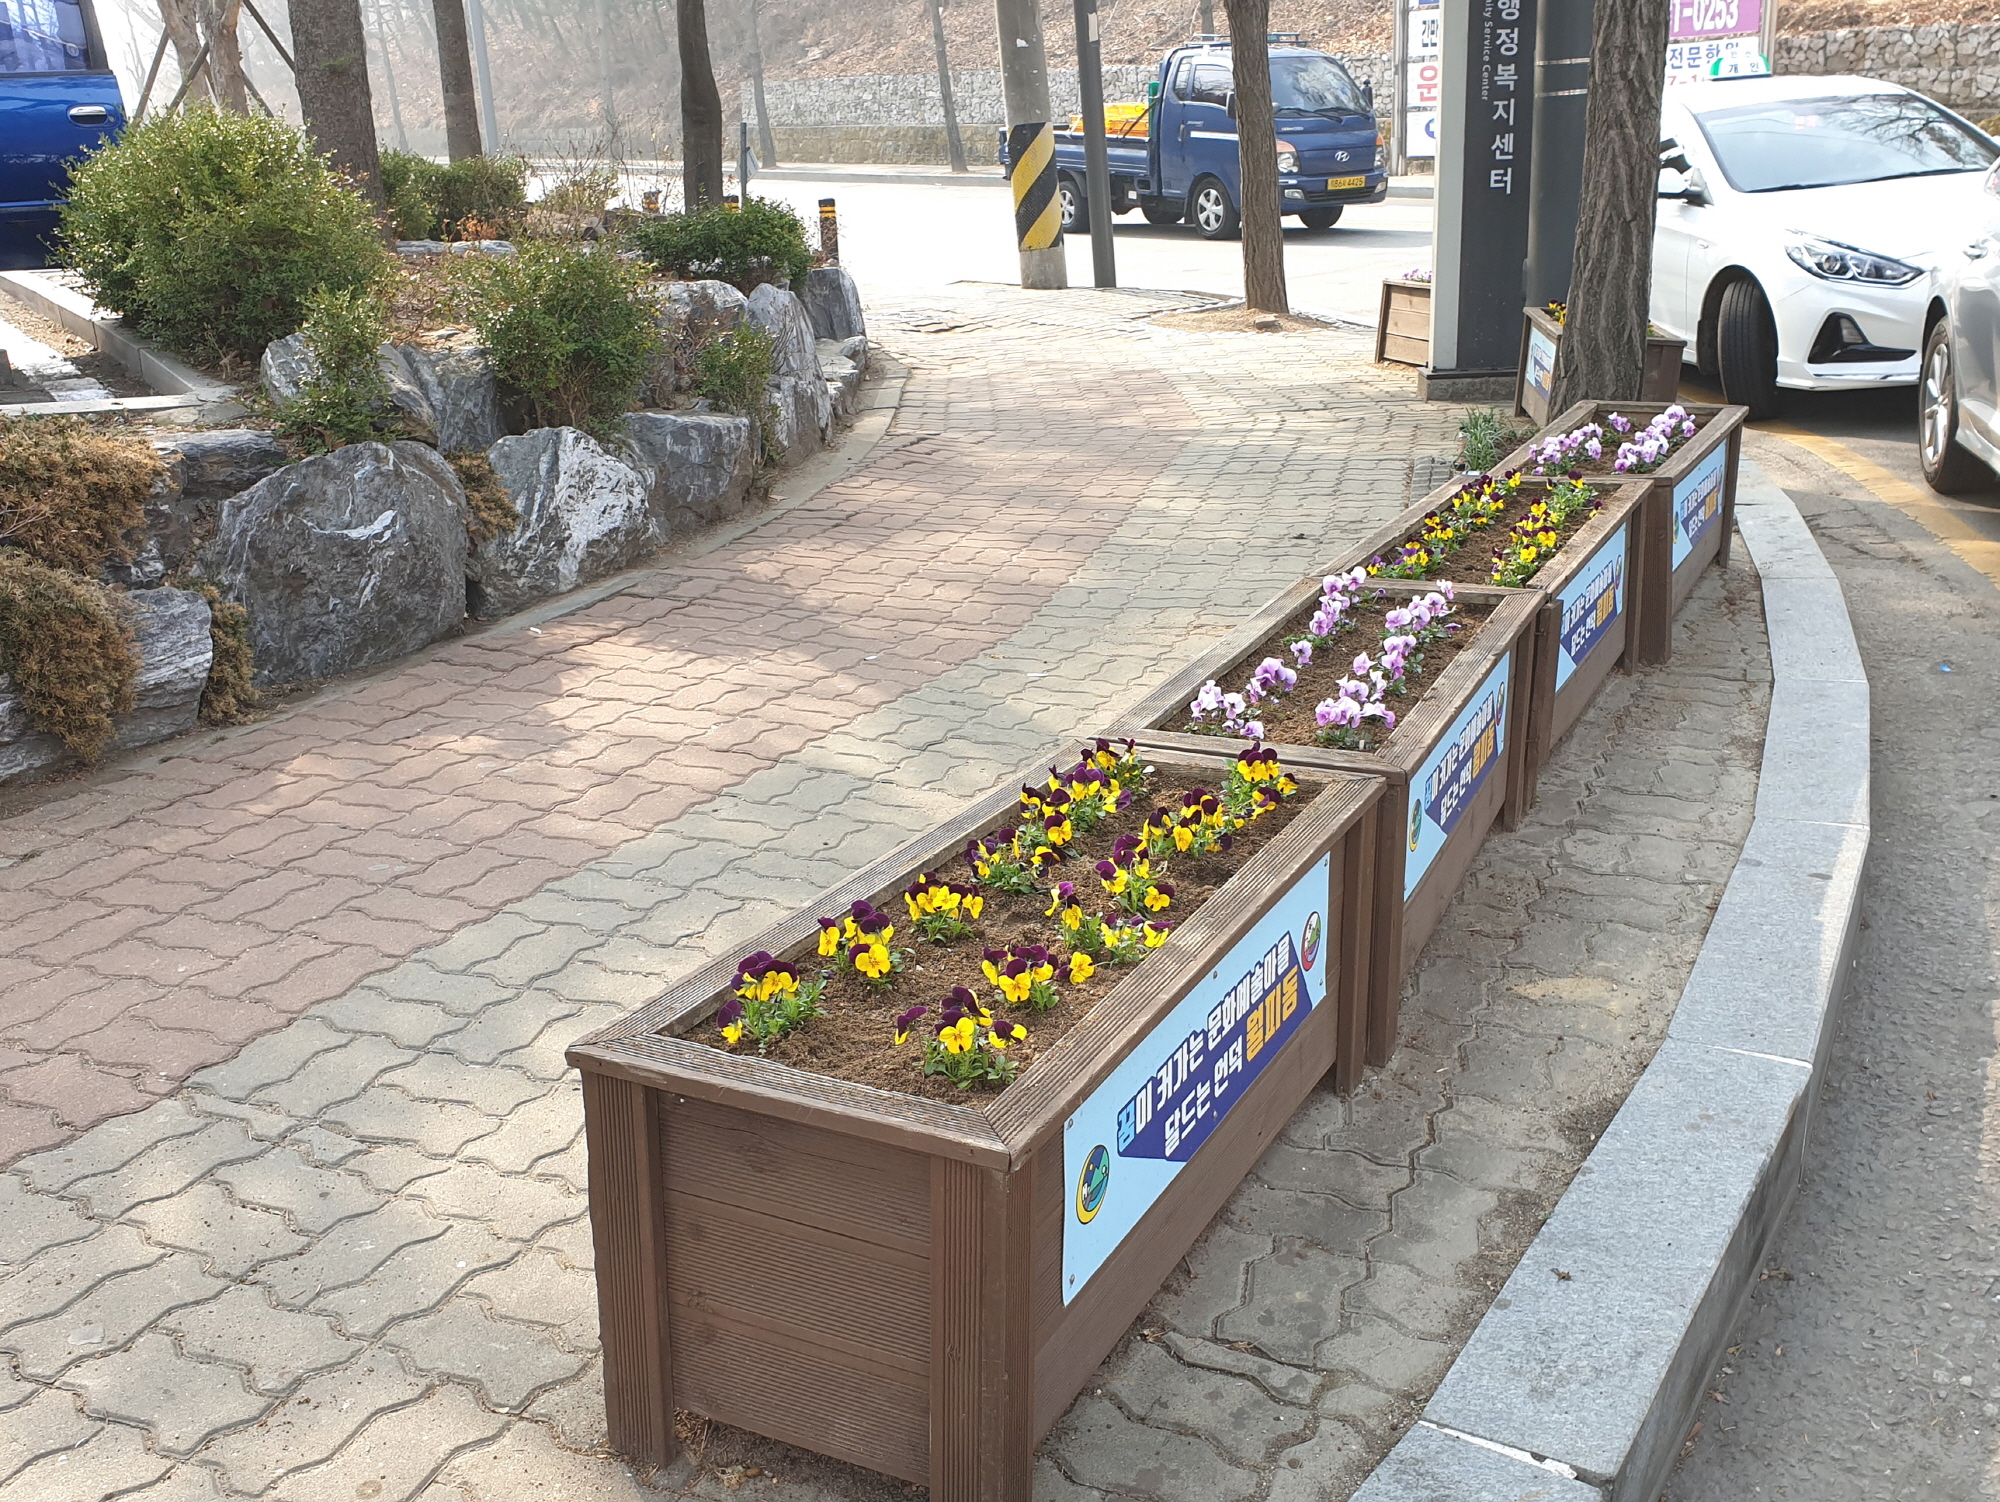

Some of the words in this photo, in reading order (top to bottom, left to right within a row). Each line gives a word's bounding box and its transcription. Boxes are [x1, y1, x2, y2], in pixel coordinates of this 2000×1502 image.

[1483, 0, 1494, 18] ity
[1483, 20, 1494, 61] Service
[1481, 64, 1491, 101] Center
[1489, 0, 1521, 195] 행정복지센터
[1118, 1079, 1153, 1153] 꿈이
[1157, 1032, 1204, 1112] 커가는
[1207, 933, 1290, 1052] 문화예술마을
[1164, 1079, 1211, 1158] 달드는
[1214, 1034, 1243, 1098] 언덕
[1246, 964, 1298, 1062] 월피동
